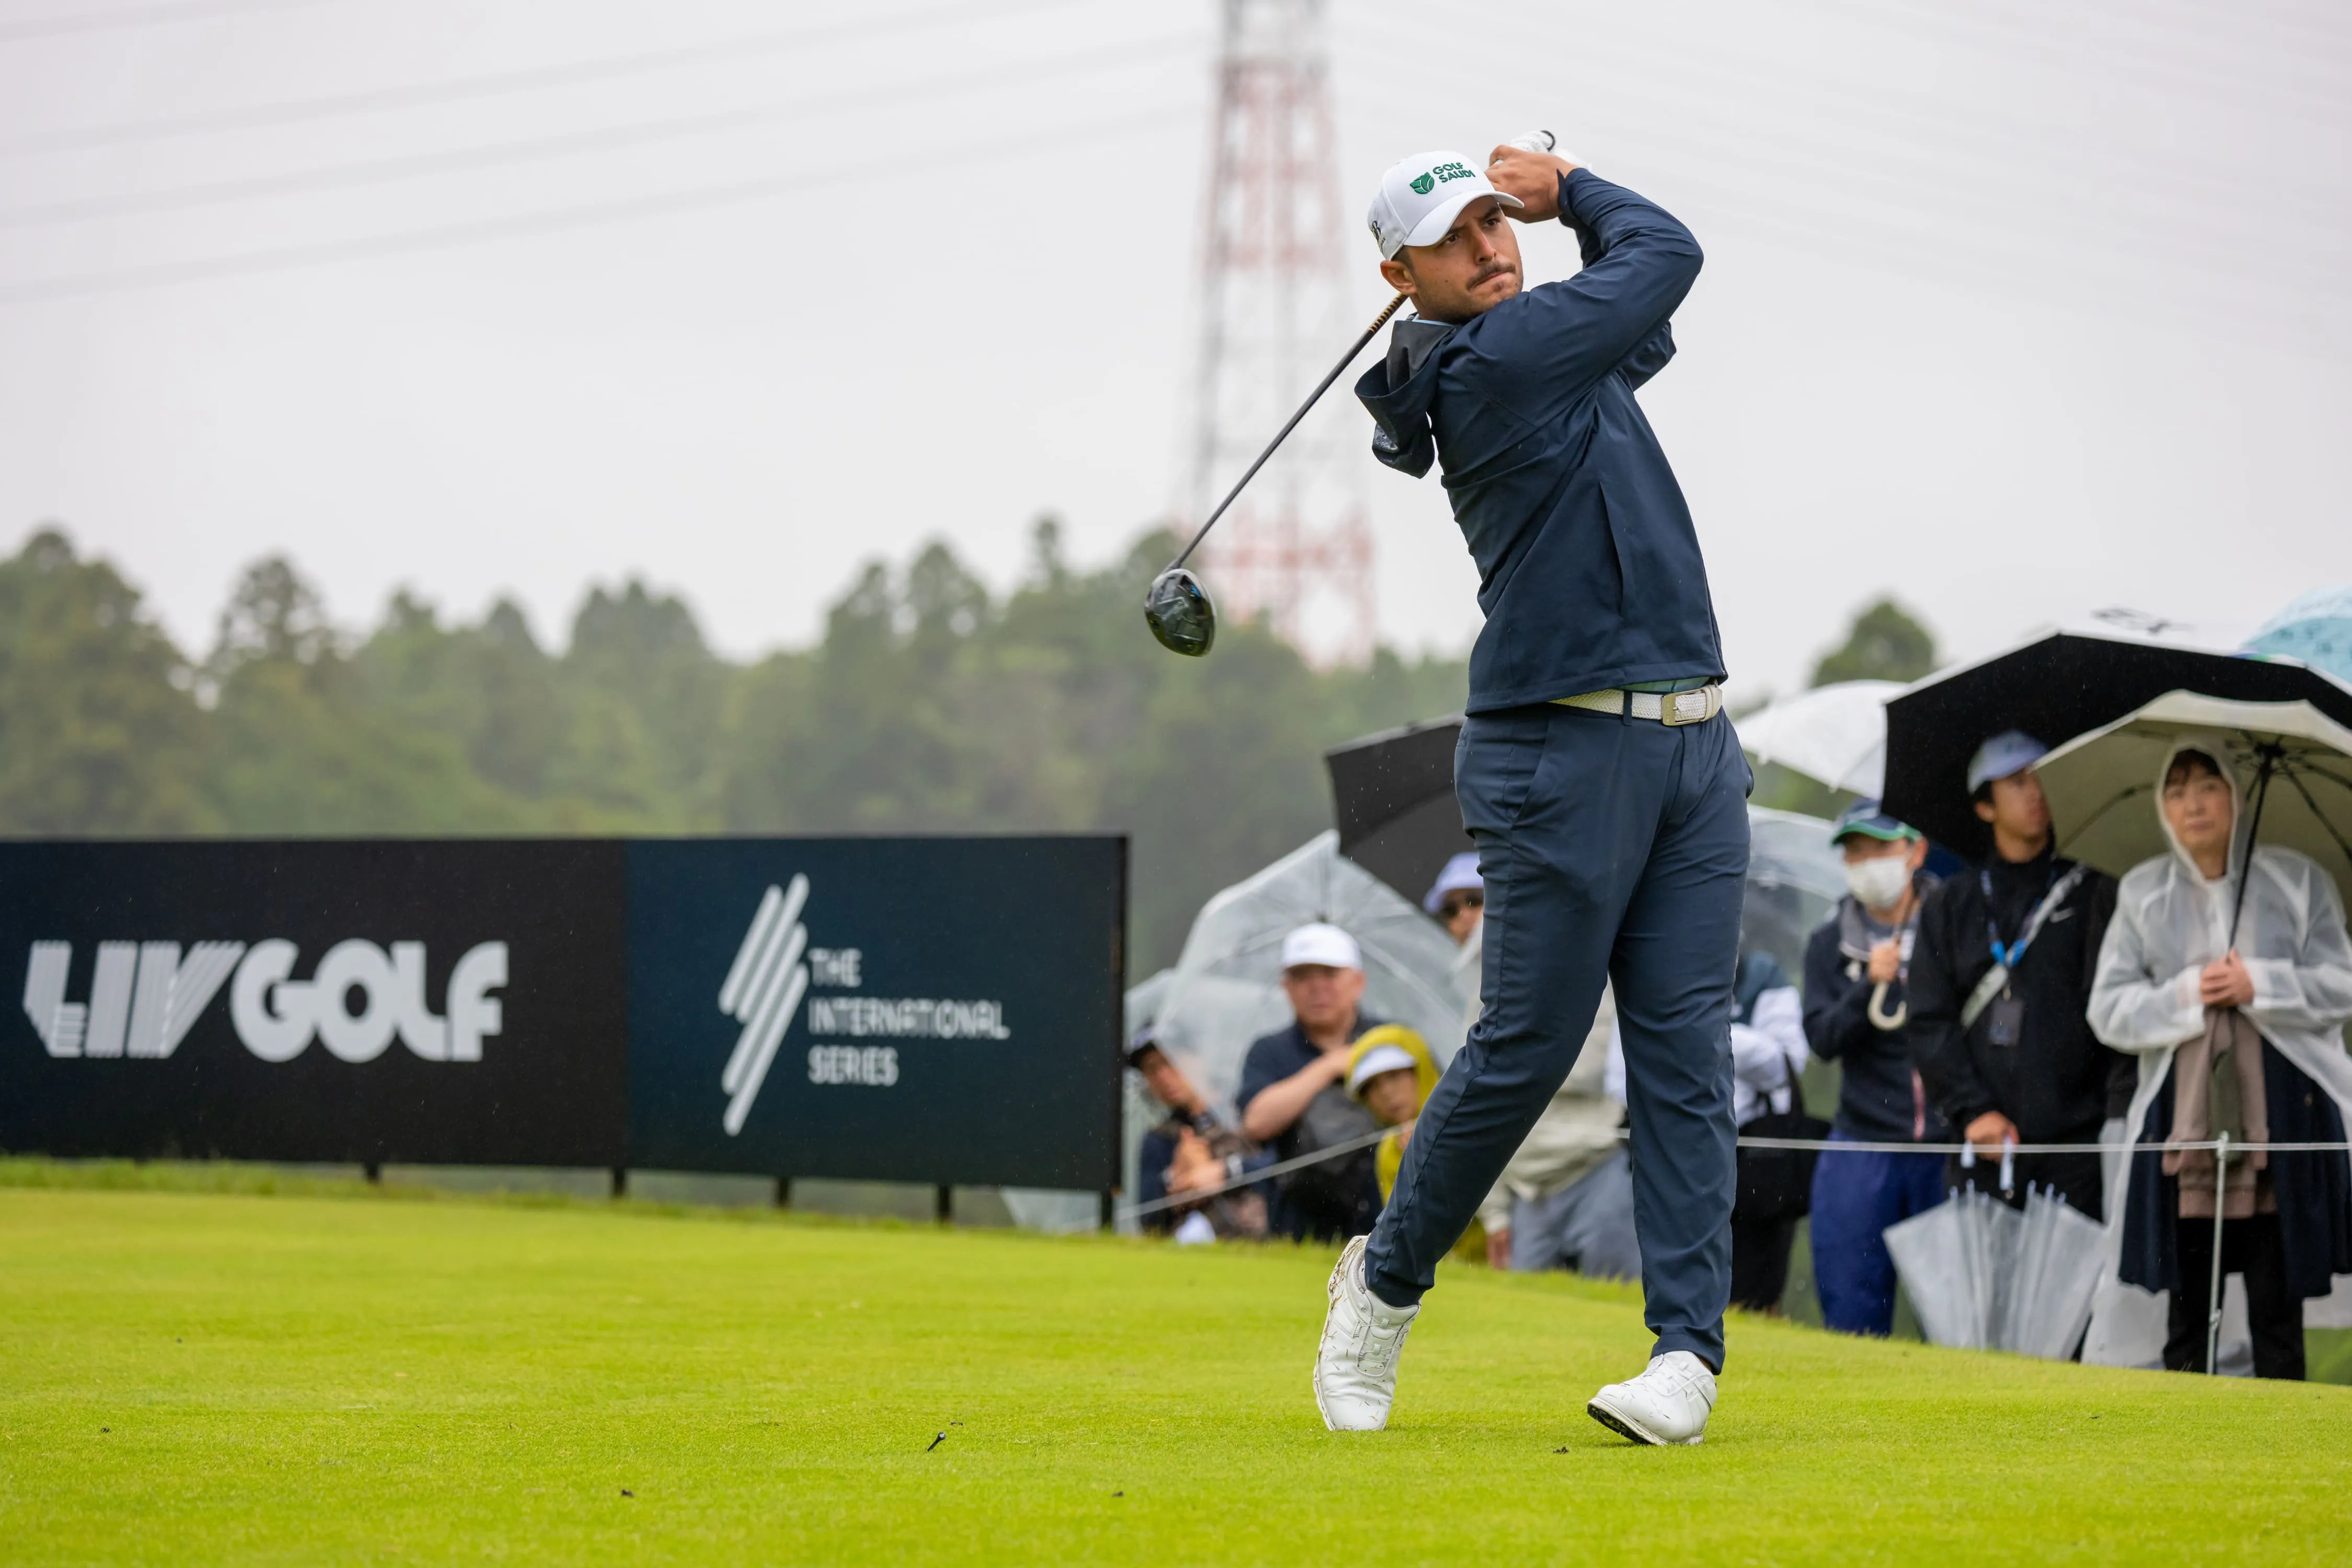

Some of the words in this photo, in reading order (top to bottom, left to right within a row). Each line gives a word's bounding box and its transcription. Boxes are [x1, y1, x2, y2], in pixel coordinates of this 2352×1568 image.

[1433, 162, 1463, 174] GOLF
[1439, 170, 1475, 183] SAUDI
[809, 948, 860, 987] THE
[24, 941, 246, 1058] LIV
[230, 939, 508, 1063] GOLF
[809, 997, 1009, 1039] INTERNATIONAL
[809, 1046, 898, 1086] SERIES
